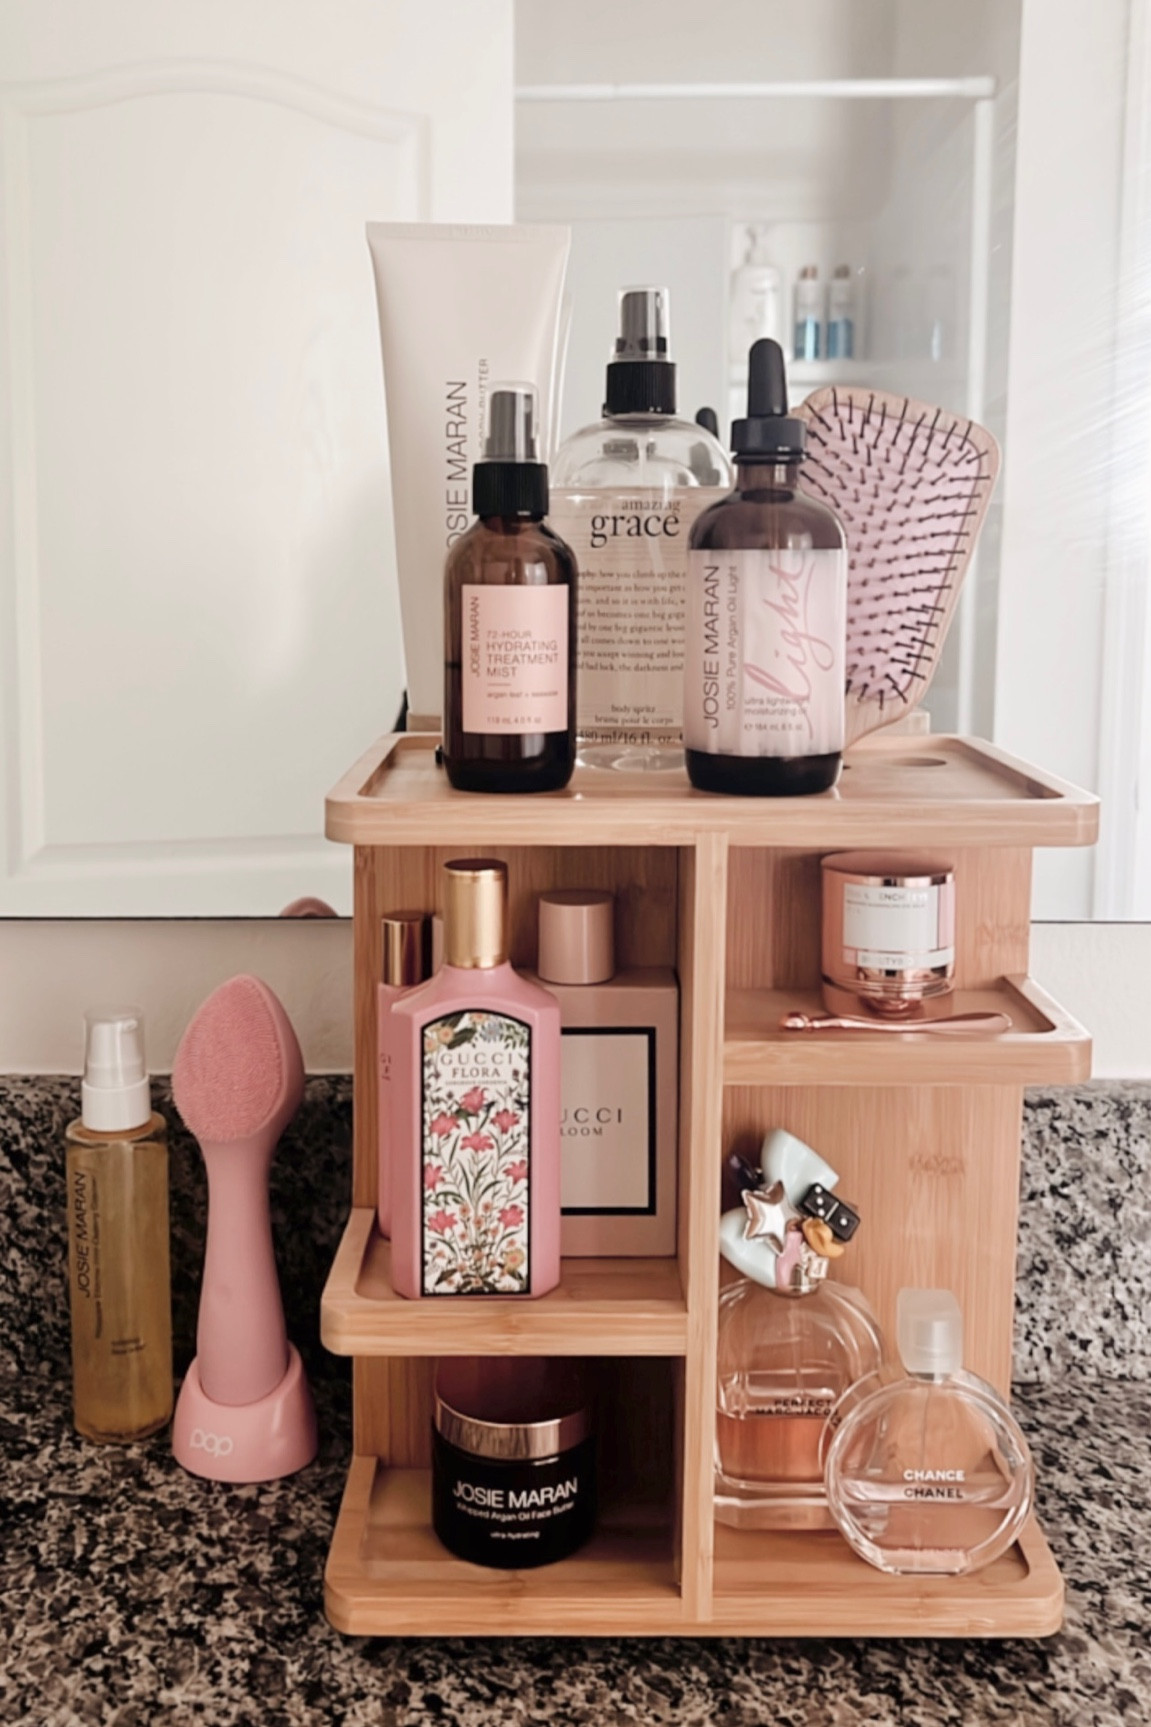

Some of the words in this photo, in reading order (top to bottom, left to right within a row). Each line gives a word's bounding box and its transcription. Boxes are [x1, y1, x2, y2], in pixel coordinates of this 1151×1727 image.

[446, 381, 466, 480] MARAN
[621, 500, 681, 514] amazing
[590, 514, 680, 549] grace
[727, 566, 740, 594] Light
[470, 596, 480, 642] MARAN
[704, 566, 720, 654] MARAN
[486, 630, 532, 639] 72-HOUR
[727, 615, 740, 648] Argan
[486, 640, 558, 652] HYDRATING
[486, 652, 559, 664] TREATMENT
[470, 644, 480, 678] JOSIE
[486, 666, 518, 678] MIST
[727, 651, 737, 678] Pure
[703, 661, 720, 728] JOSIE
[726, 682, 736, 710] 100%
[611, 704, 630, 714] body
[744, 708, 796, 718] moisturizing
[440, 1052, 513, 1066] GUCCI
[452, 1067, 501, 1078] FLORA
[74, 1171, 88, 1239] MARAN
[77, 1240, 90, 1298] JOSIE
[755, 1408, 792, 1416] MARC
[903, 1470, 966, 1482] CHANCE
[453, 1480, 504, 1508] JOSIE
[508, 1477, 578, 1508] MARAN
[904, 1488, 964, 1499] CHANEL
[490, 1510, 517, 1522] Argan
[518, 1510, 530, 1521] Oil
[532, 1508, 551, 1520] Face
[553, 1501, 574, 1516] Butter
